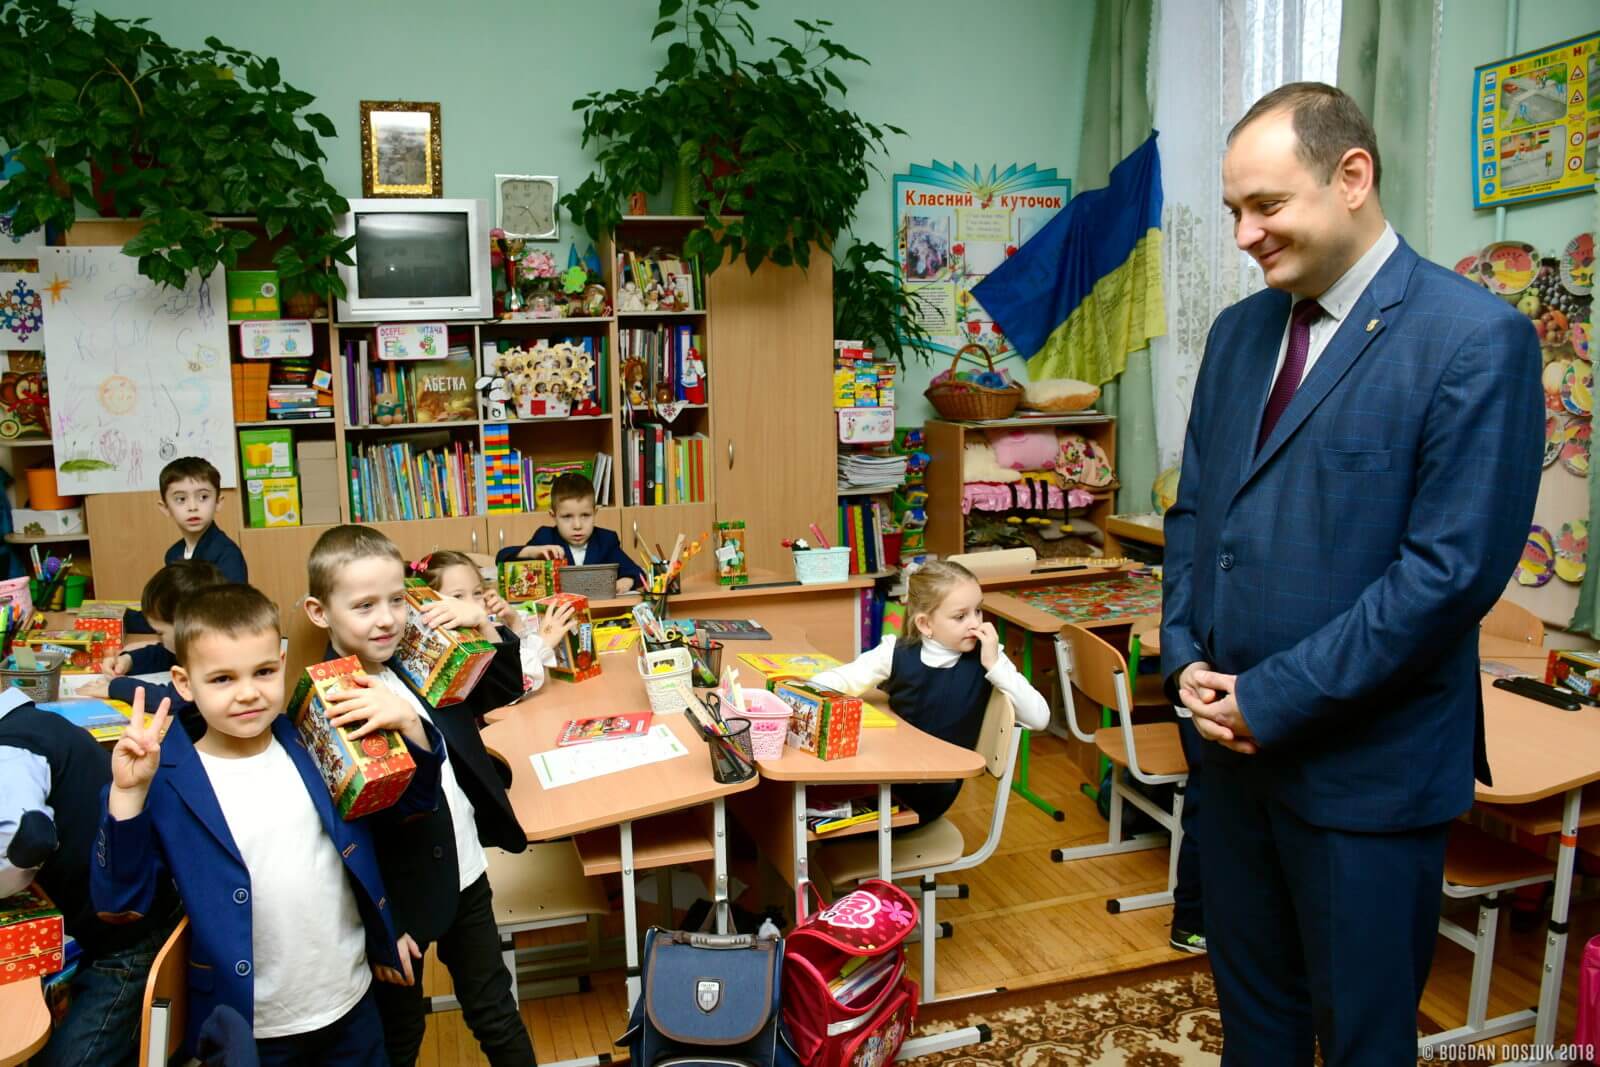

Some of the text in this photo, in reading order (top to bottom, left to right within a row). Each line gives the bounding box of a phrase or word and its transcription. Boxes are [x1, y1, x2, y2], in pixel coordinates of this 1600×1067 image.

[905, 190, 1062, 212] Класний куточок
[424, 375, 468, 393] АБЕТКА
